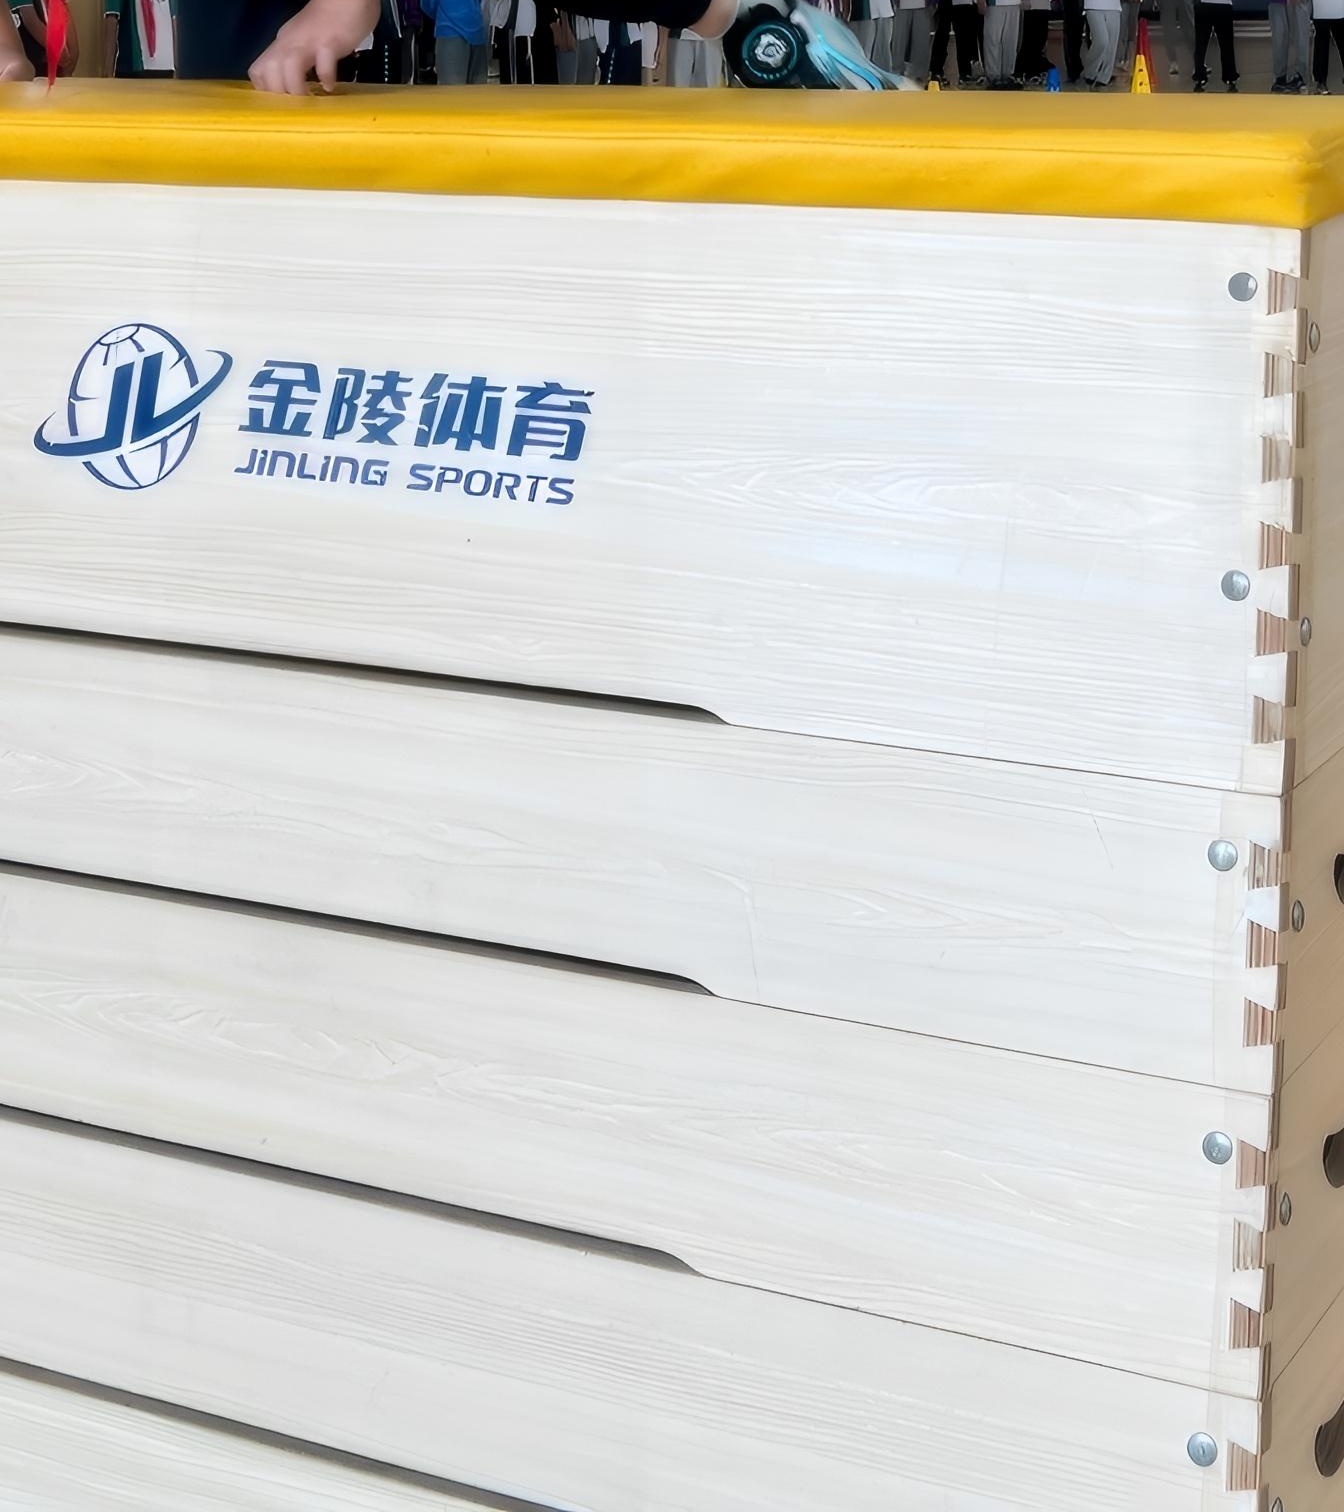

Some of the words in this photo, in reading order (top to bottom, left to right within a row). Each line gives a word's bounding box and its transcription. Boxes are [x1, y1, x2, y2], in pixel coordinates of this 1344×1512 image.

[237, 359, 596, 462] 金陵体育
[406, 462, 575, 506] SPORTS
